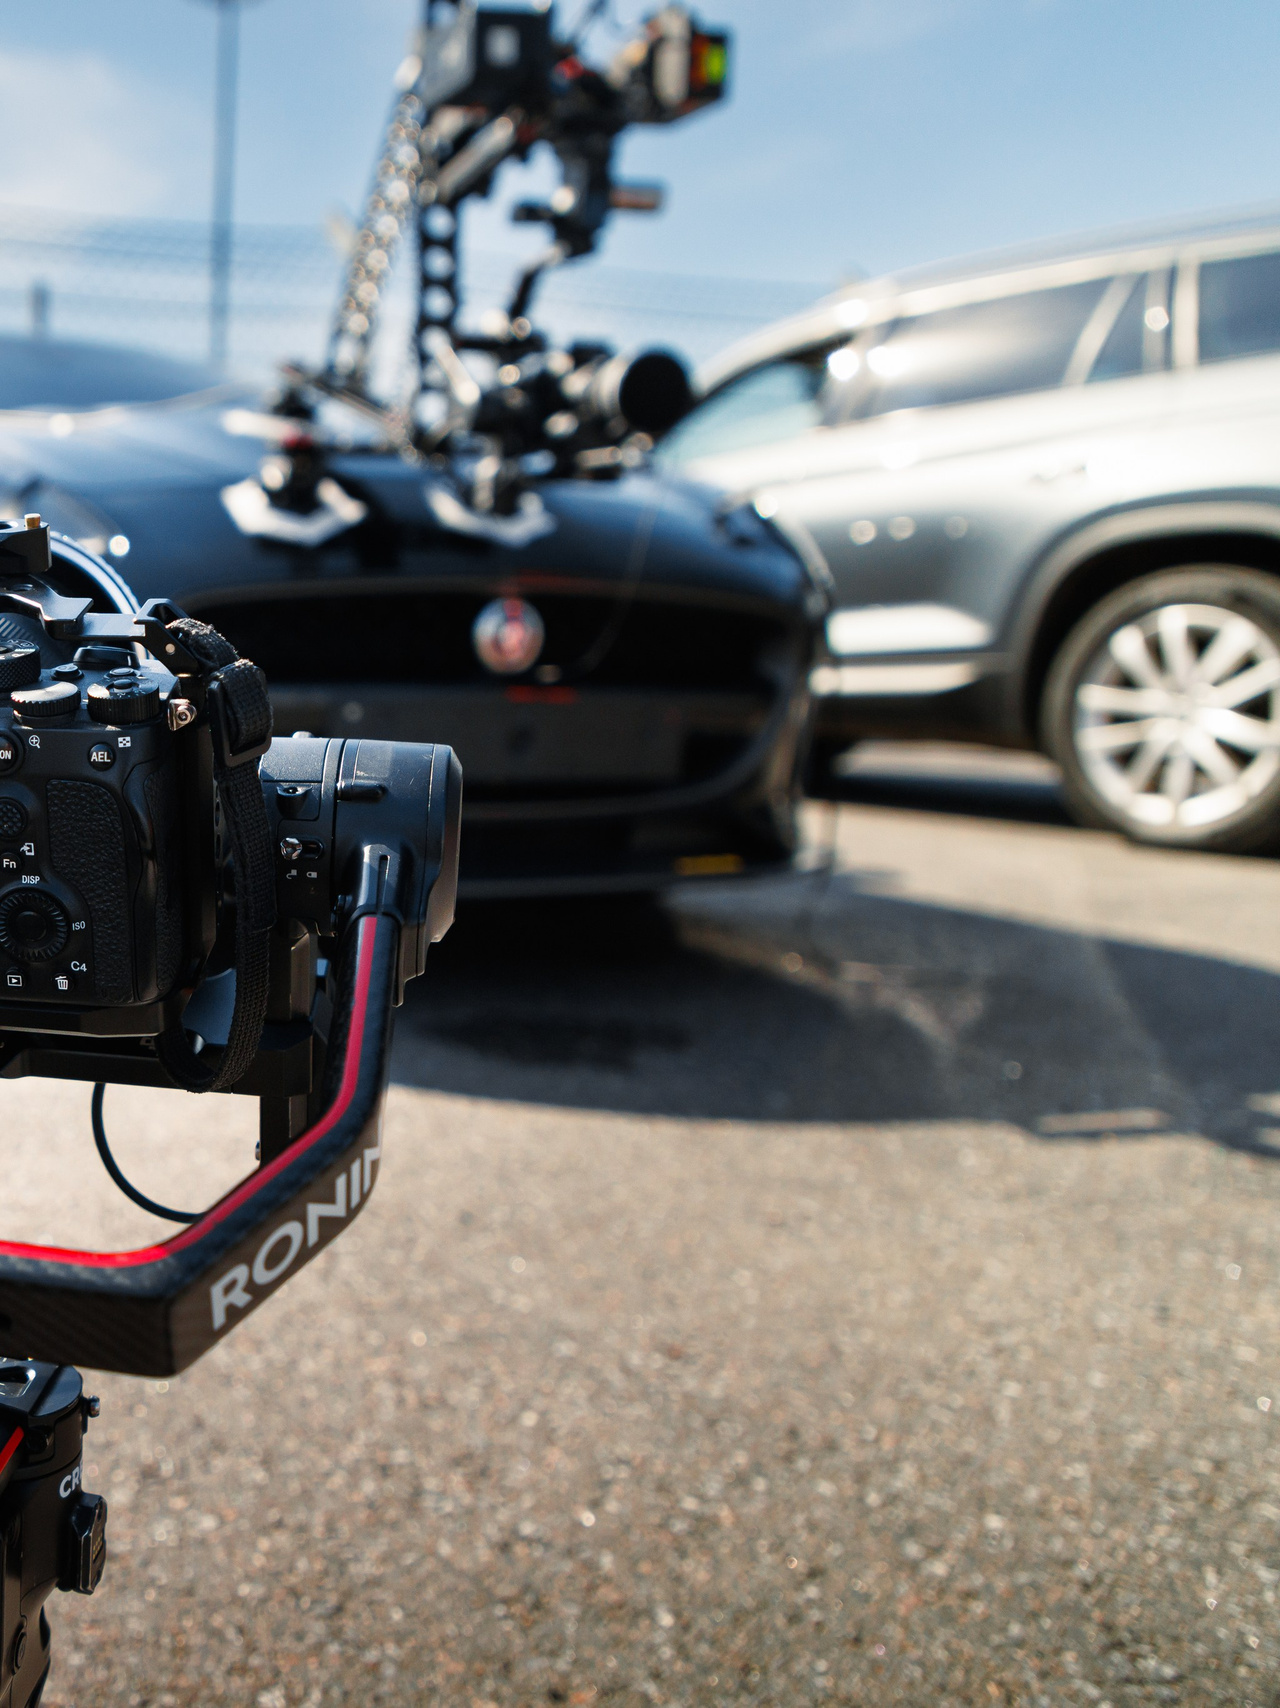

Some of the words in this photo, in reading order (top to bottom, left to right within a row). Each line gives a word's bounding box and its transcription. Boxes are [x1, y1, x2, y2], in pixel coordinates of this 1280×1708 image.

[90, 751, 111, 762] AEL
[3, 859, 16, 868] Fn
[21, 875, 40, 884] DISP
[72, 921, 86, 931] ISO
[71, 961, 87, 972] C4
